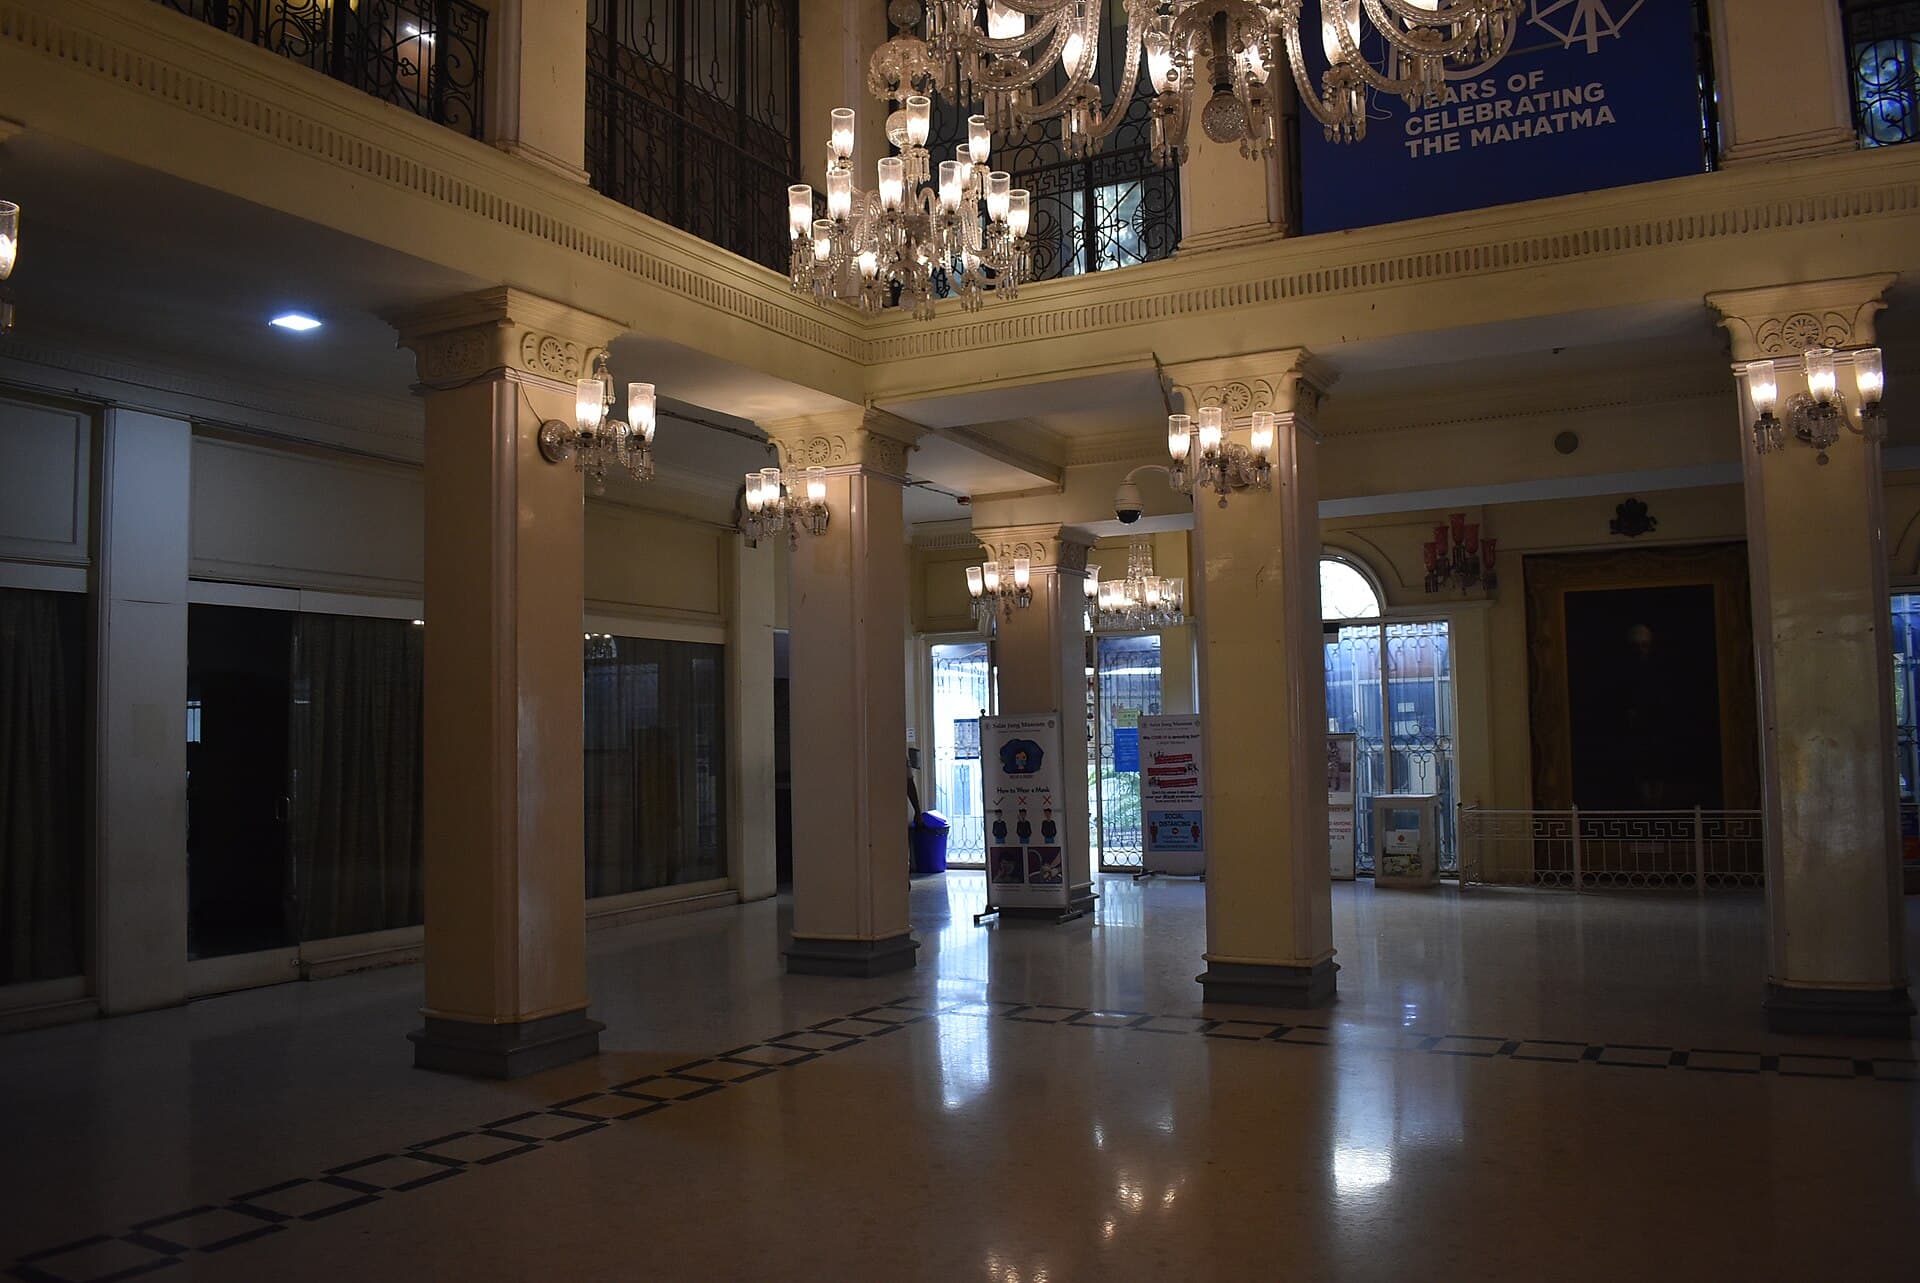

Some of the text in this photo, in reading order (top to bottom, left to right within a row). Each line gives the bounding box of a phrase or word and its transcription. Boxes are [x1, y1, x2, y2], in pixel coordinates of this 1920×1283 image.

[1507, 70, 1544, 93] OF
[1405, 82, 1605, 136] CELEBRATING
[1405, 105, 1616, 159] THE MAHATMA
